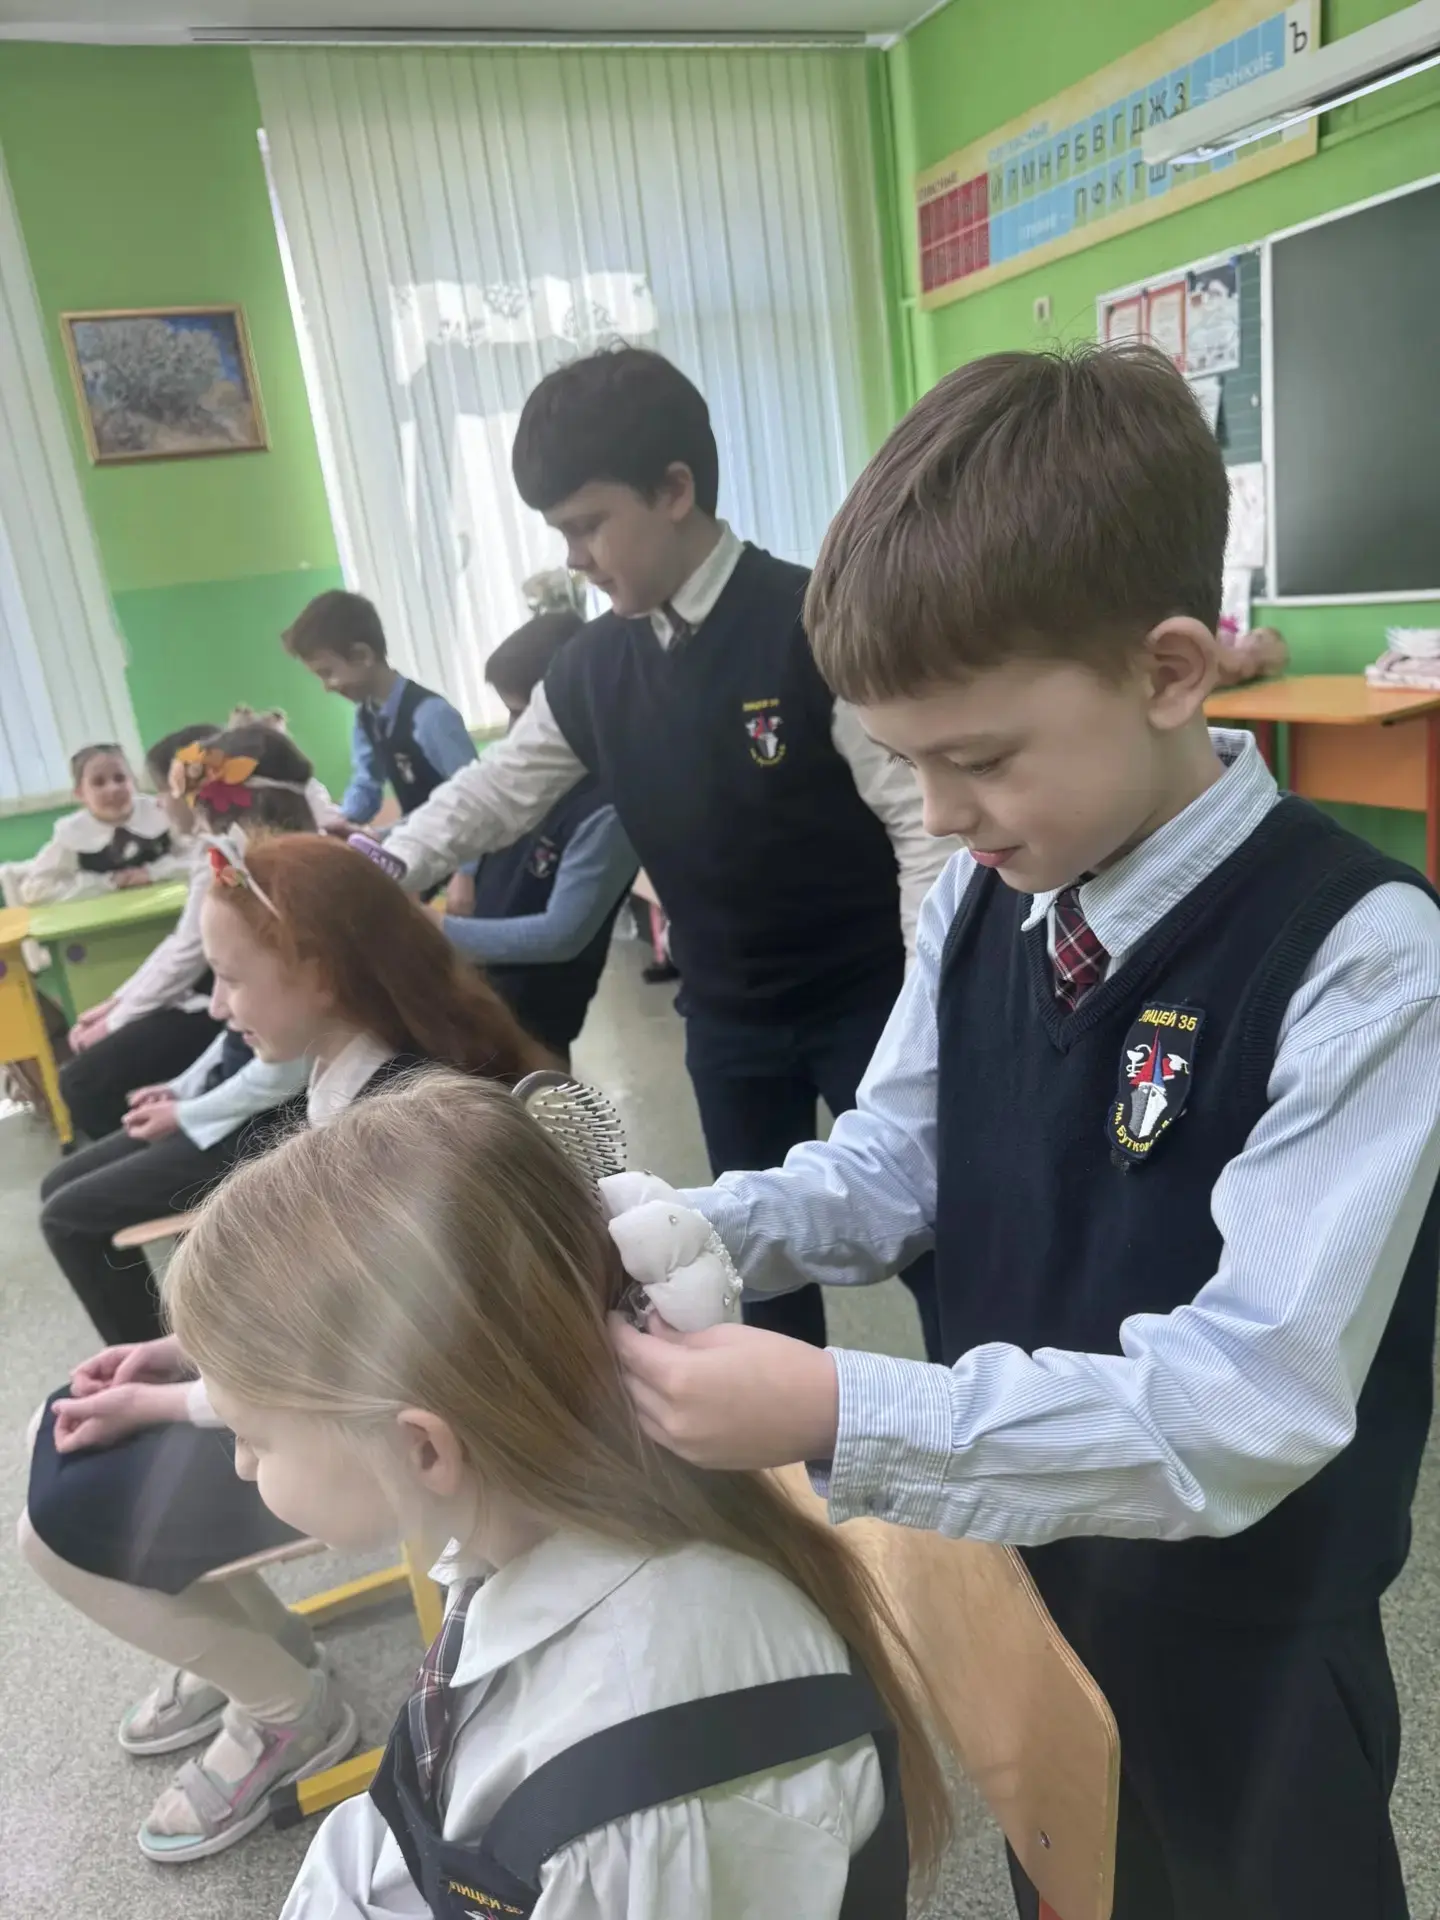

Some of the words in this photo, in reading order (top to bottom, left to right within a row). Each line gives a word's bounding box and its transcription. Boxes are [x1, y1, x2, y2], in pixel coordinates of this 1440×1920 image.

[1289, 21, 1308, 54] Ъ
[1057, 143, 1068, 171] Р
[1075, 133, 1087, 162] Б
[1093, 124, 1105, 152] В
[1113, 113, 1123, 144] Г
[1130, 104, 1144, 143] Д
[1149, 89, 1168, 127] Ж
[1111, 168, 1123, 200] К
[1138, 1009, 1177, 1028] ЛИЦЕЙ
[1178, 1014, 1198, 1031] 35
